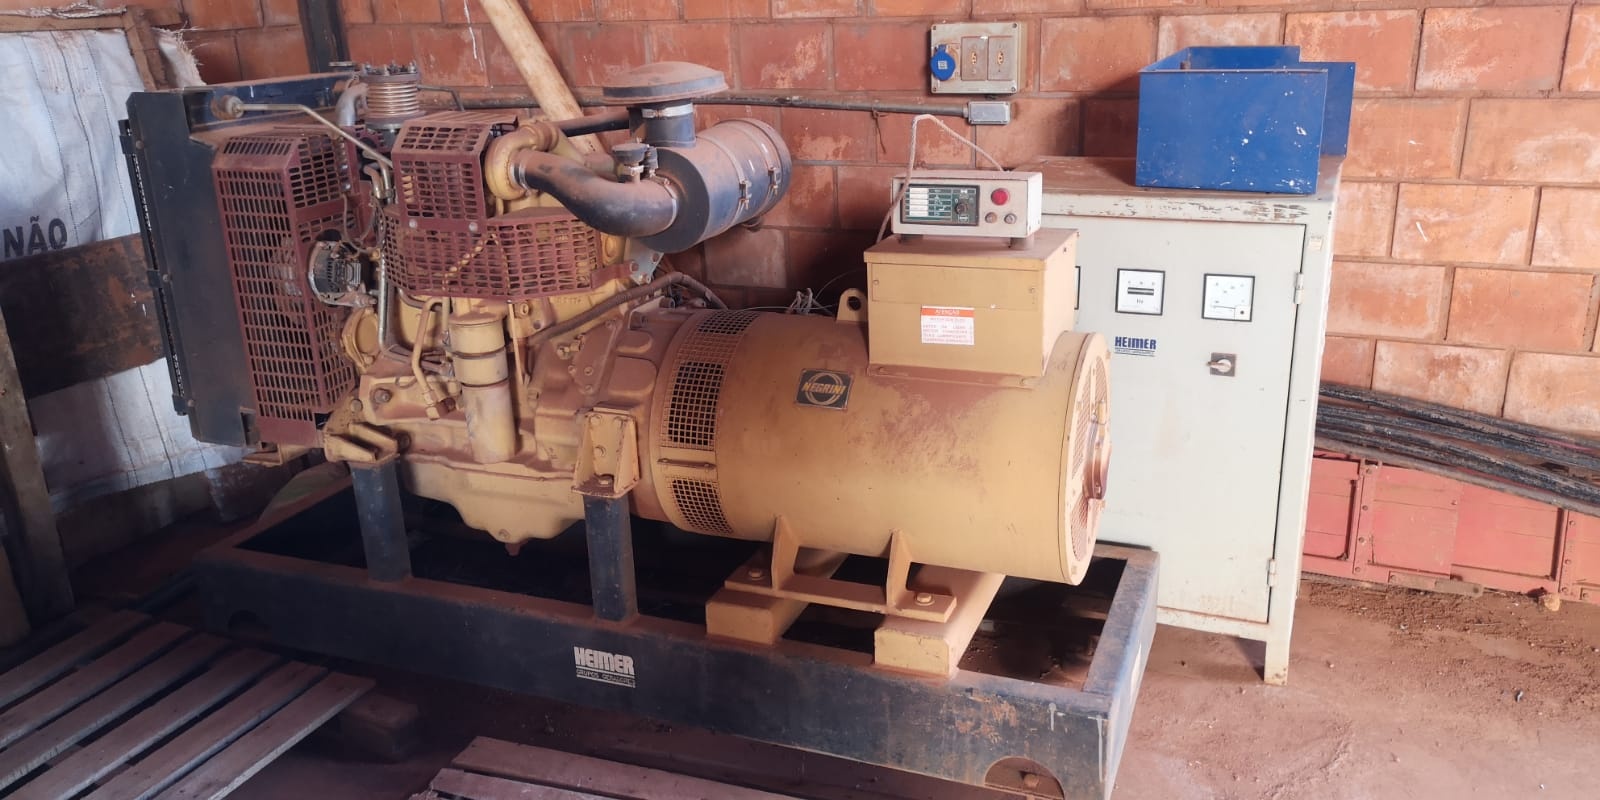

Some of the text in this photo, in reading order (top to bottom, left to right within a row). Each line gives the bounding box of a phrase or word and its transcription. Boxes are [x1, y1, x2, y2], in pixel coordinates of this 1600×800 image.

[3, 215, 67, 258] NÃO
[1114, 336, 1157, 350] HEIMER
[801, 382, 847, 395] NEGRINI
[574, 646, 635, 675] HEIMER
